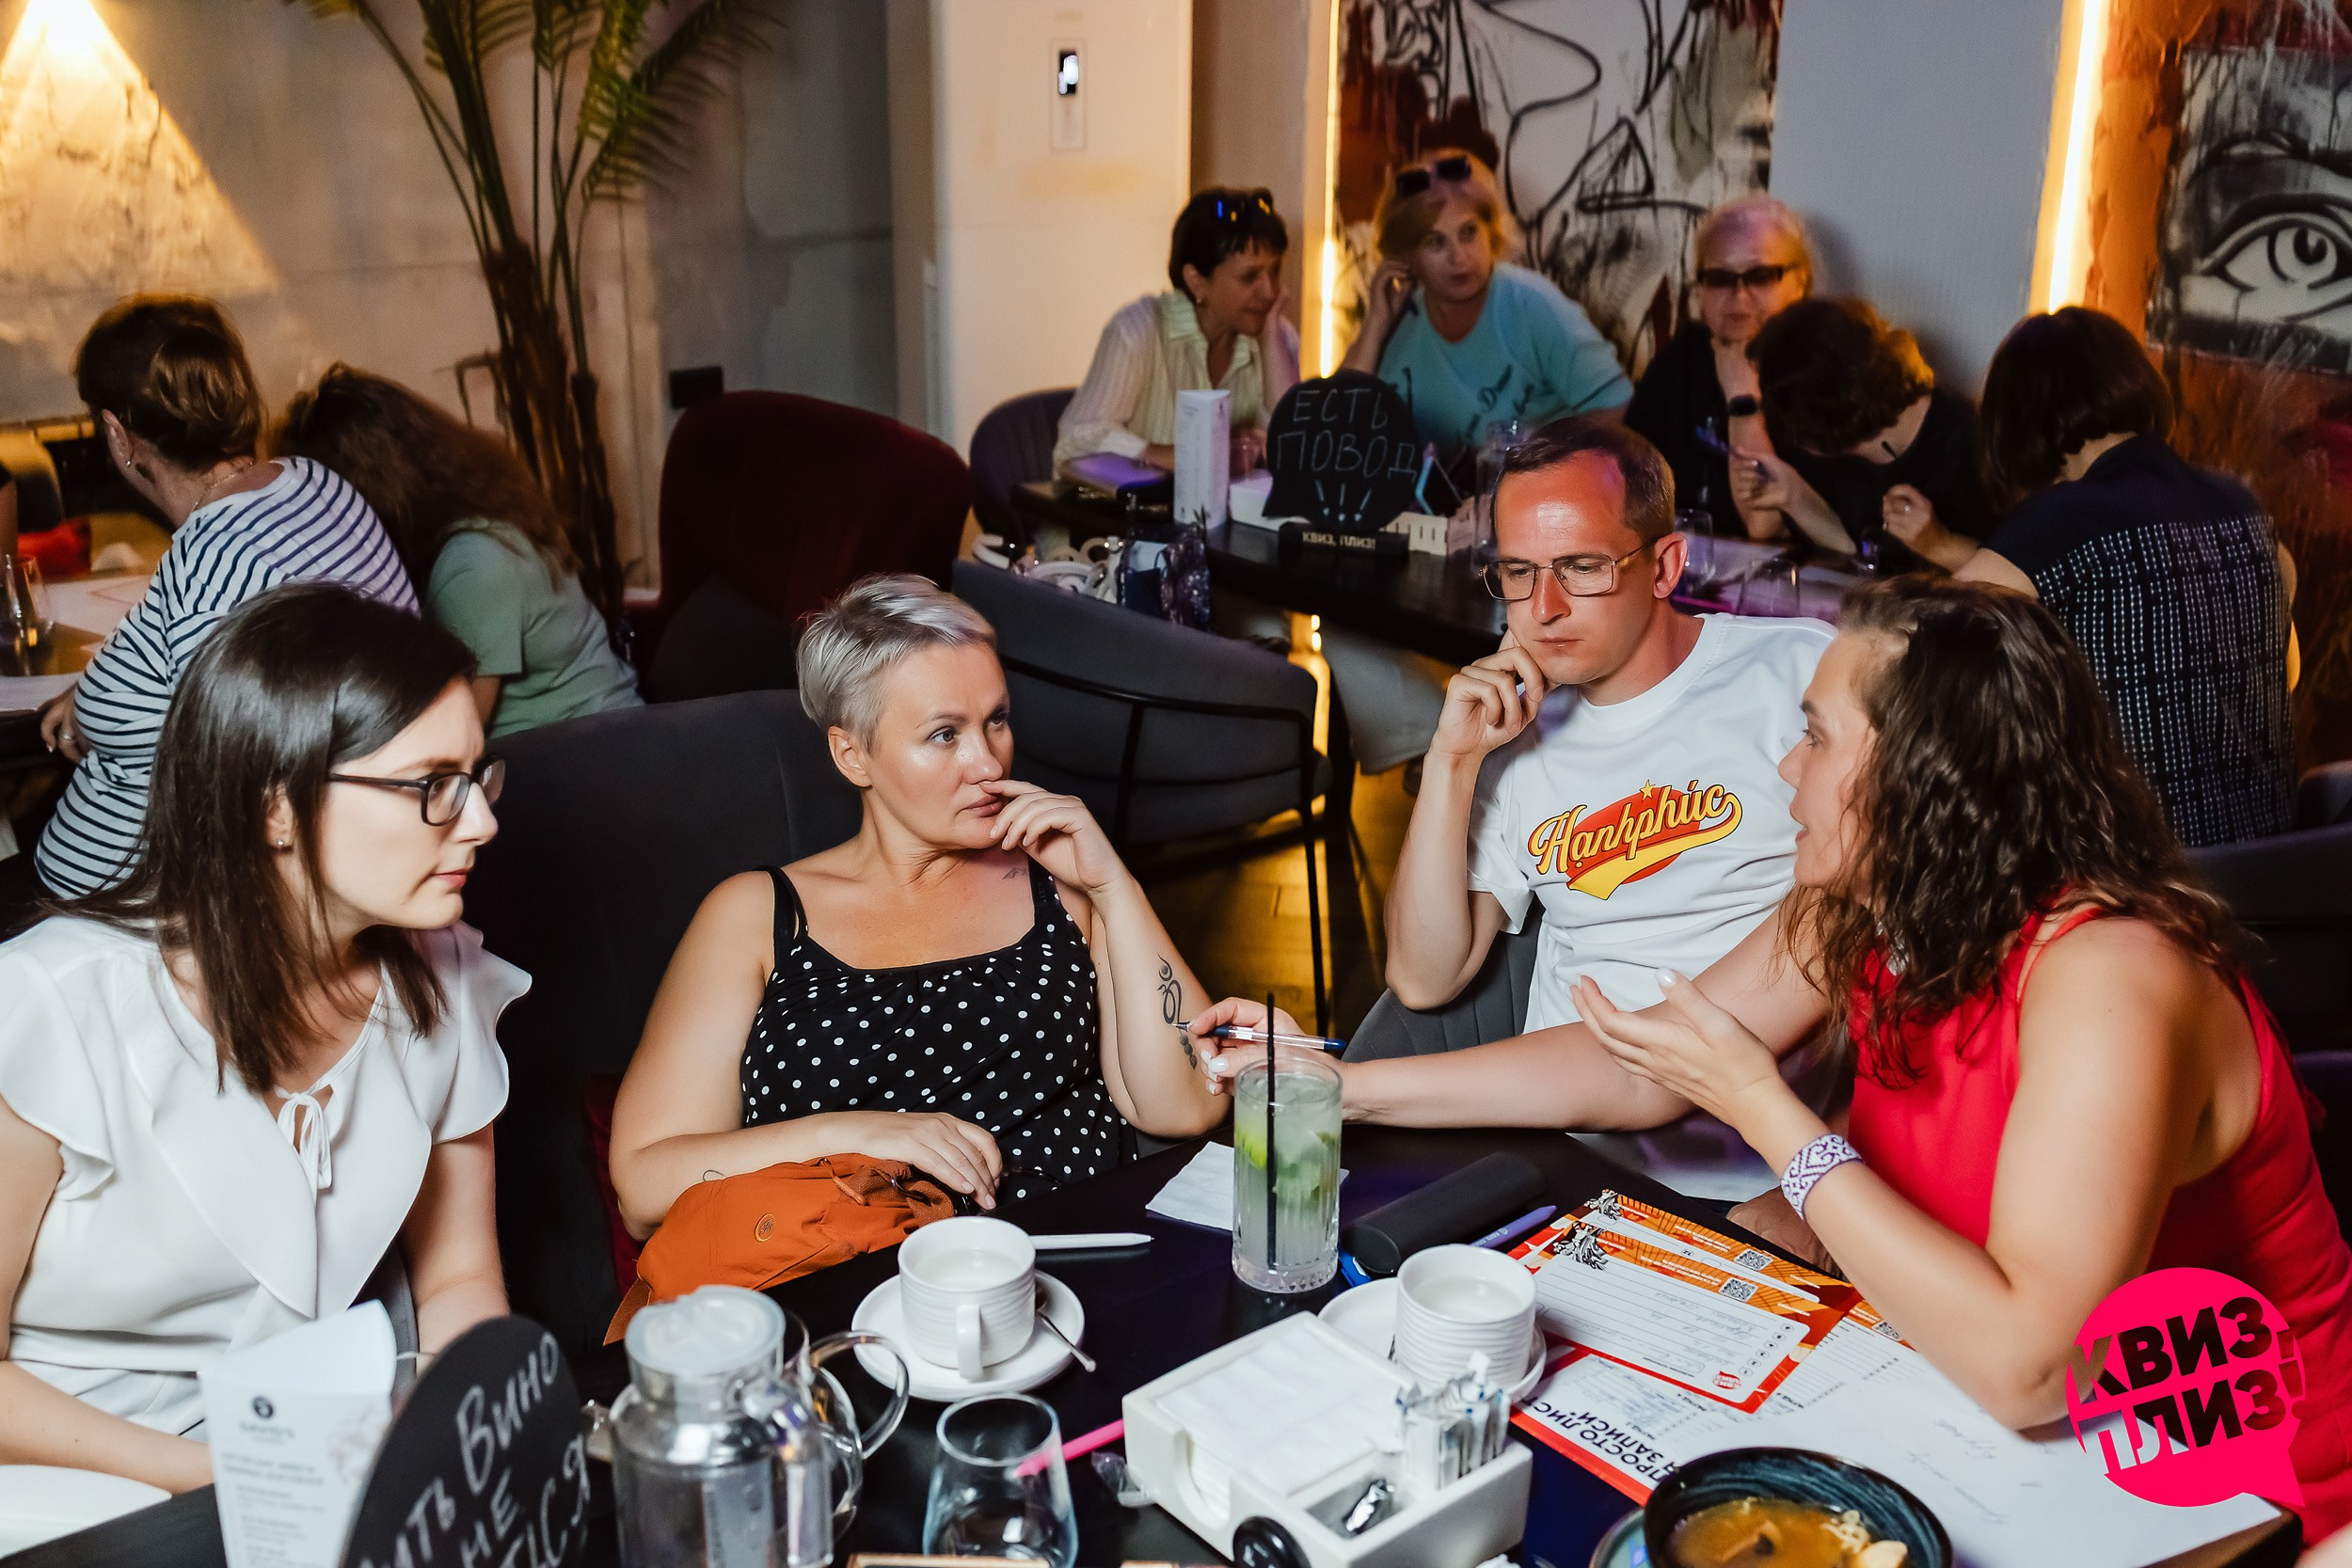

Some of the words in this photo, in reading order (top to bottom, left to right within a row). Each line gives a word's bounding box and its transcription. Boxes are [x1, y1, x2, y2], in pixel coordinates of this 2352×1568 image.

[1293, 388, 1388, 429] ЕСТЬ
[1276, 430, 1417, 483] ПОВОД
[1521, 1397, 1581, 1430] ЛИСТ
[1580, 1429, 1667, 1481] ПРОСТО
